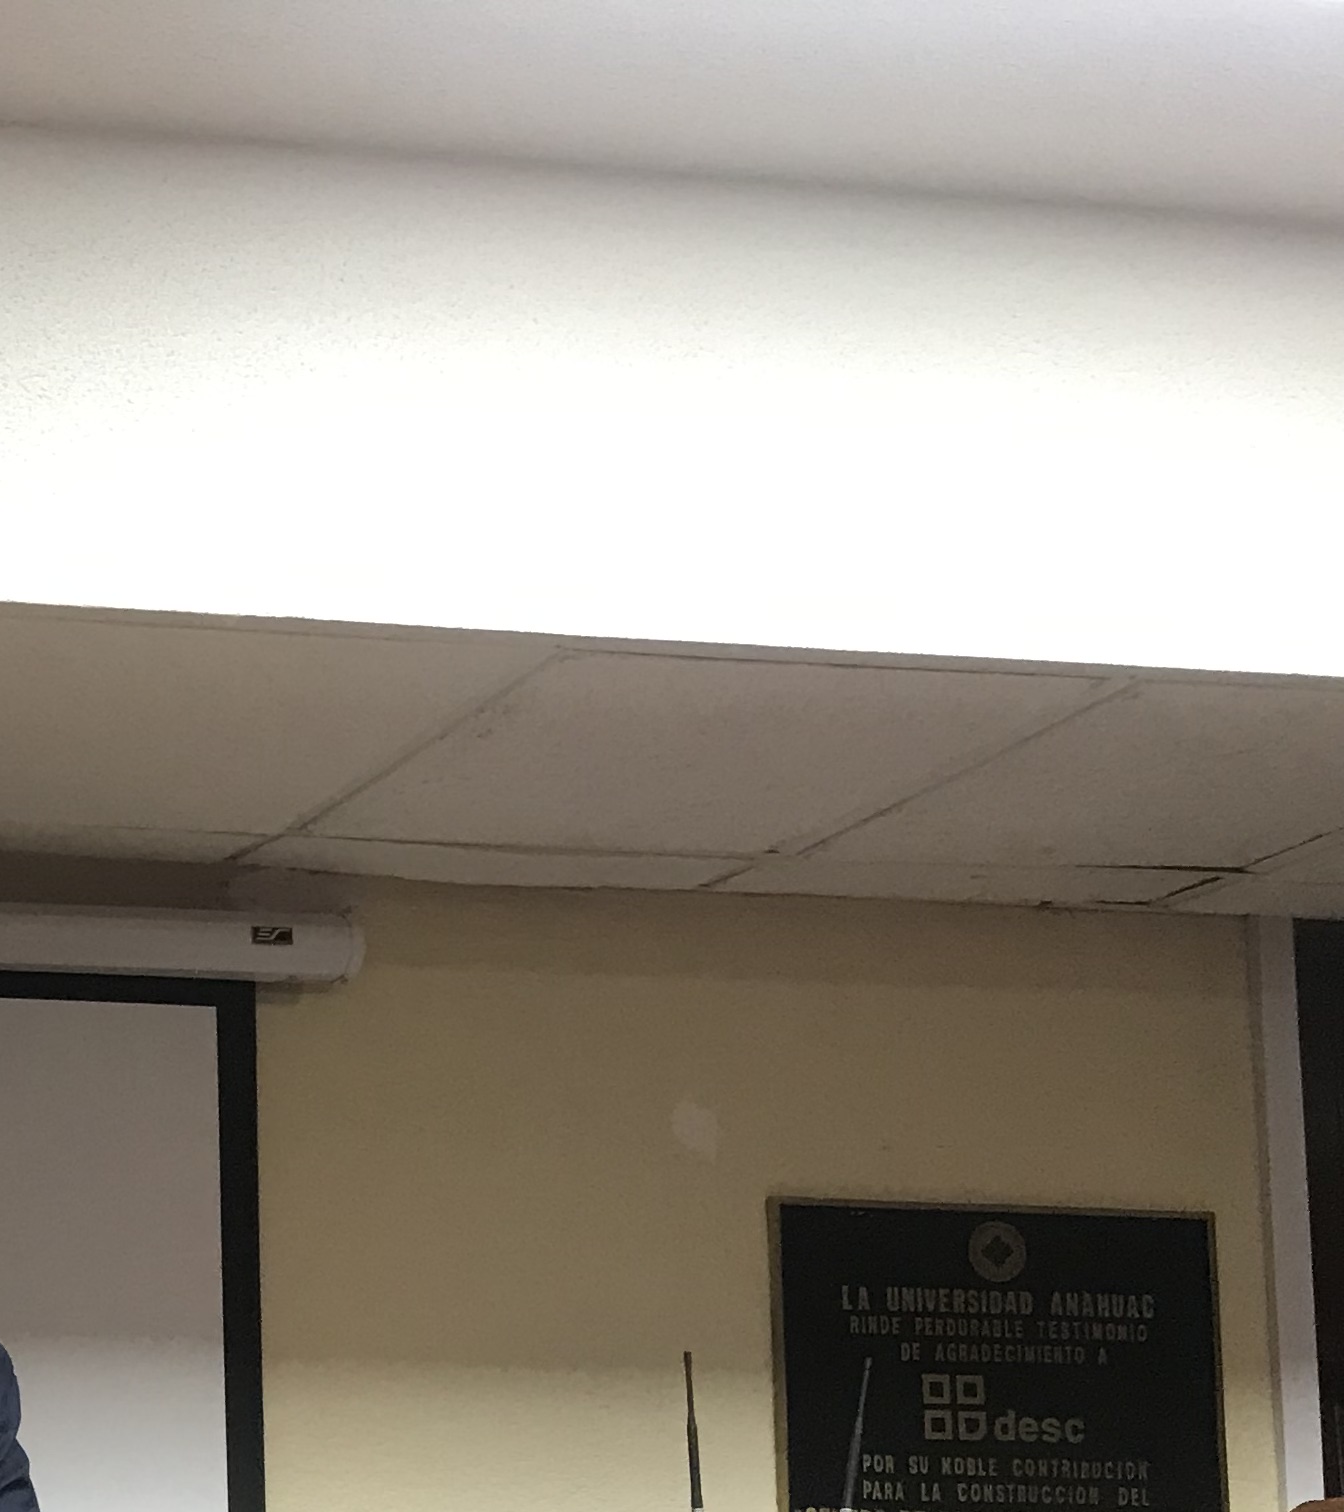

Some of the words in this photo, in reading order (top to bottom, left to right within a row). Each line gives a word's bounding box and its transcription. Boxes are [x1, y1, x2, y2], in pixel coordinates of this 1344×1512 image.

[841, 1285, 871, 1311] LA
[886, 1286, 1034, 1316] UNIVERSIDAD
[850, 1314, 901, 1336] RINDE
[914, 1317, 1023, 1339] PERDURABLE
[1036, 1320, 1148, 1343] TESTIMONIO
[900, 1341, 921, 1362] DE
[935, 1343, 1086, 1365] AGRADECIMIENTO
[1098, 1347, 1108, 1366] A
[994, 1410, 1085, 1443] desc
[862, 1454, 895, 1474] POR
[909, 1455, 929, 1475] SU
[941, 1457, 998, 1477] NOBLE
[1012, 1458, 1151, 1481] CONTRIBUCION
[863, 1479, 905, 1501] PARA
[920, 1482, 942, 1502] LA
[957, 1483, 1100, 1505] CONSTRUCCION
[1118, 1486, 1151, 1507] DEL
